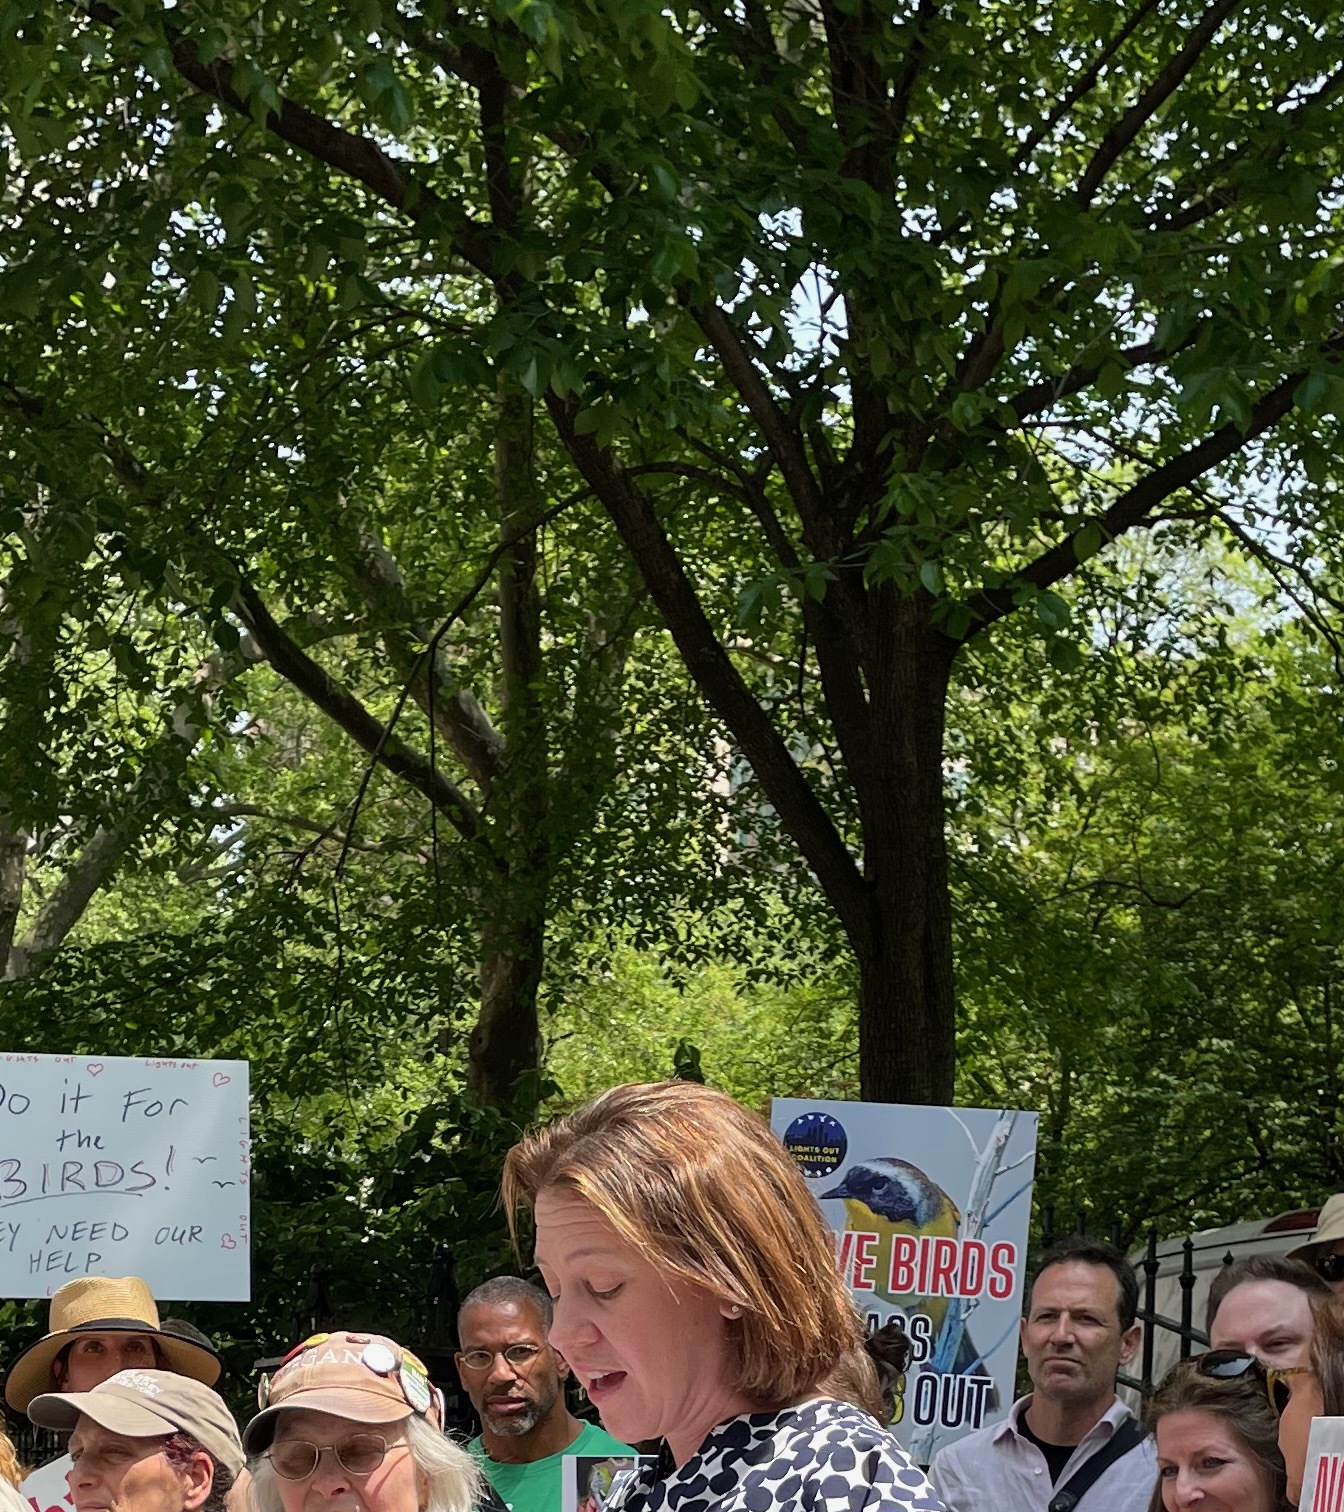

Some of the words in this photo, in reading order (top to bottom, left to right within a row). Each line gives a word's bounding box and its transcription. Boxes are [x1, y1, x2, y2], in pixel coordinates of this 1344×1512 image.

[60, 1078, 93, 1114] it
[122, 1087, 189, 1123] For
[56, 1129, 105, 1152] the
[790, 1145, 820, 1154] LIGHTS
[822, 1146, 840, 1155] OUT
[45, 1221, 129, 1245] NEED
[154, 1225, 204, 1245] OUR
[891, 1235, 1017, 1301] BIRDS
[915, 1374, 991, 1429] OUT
